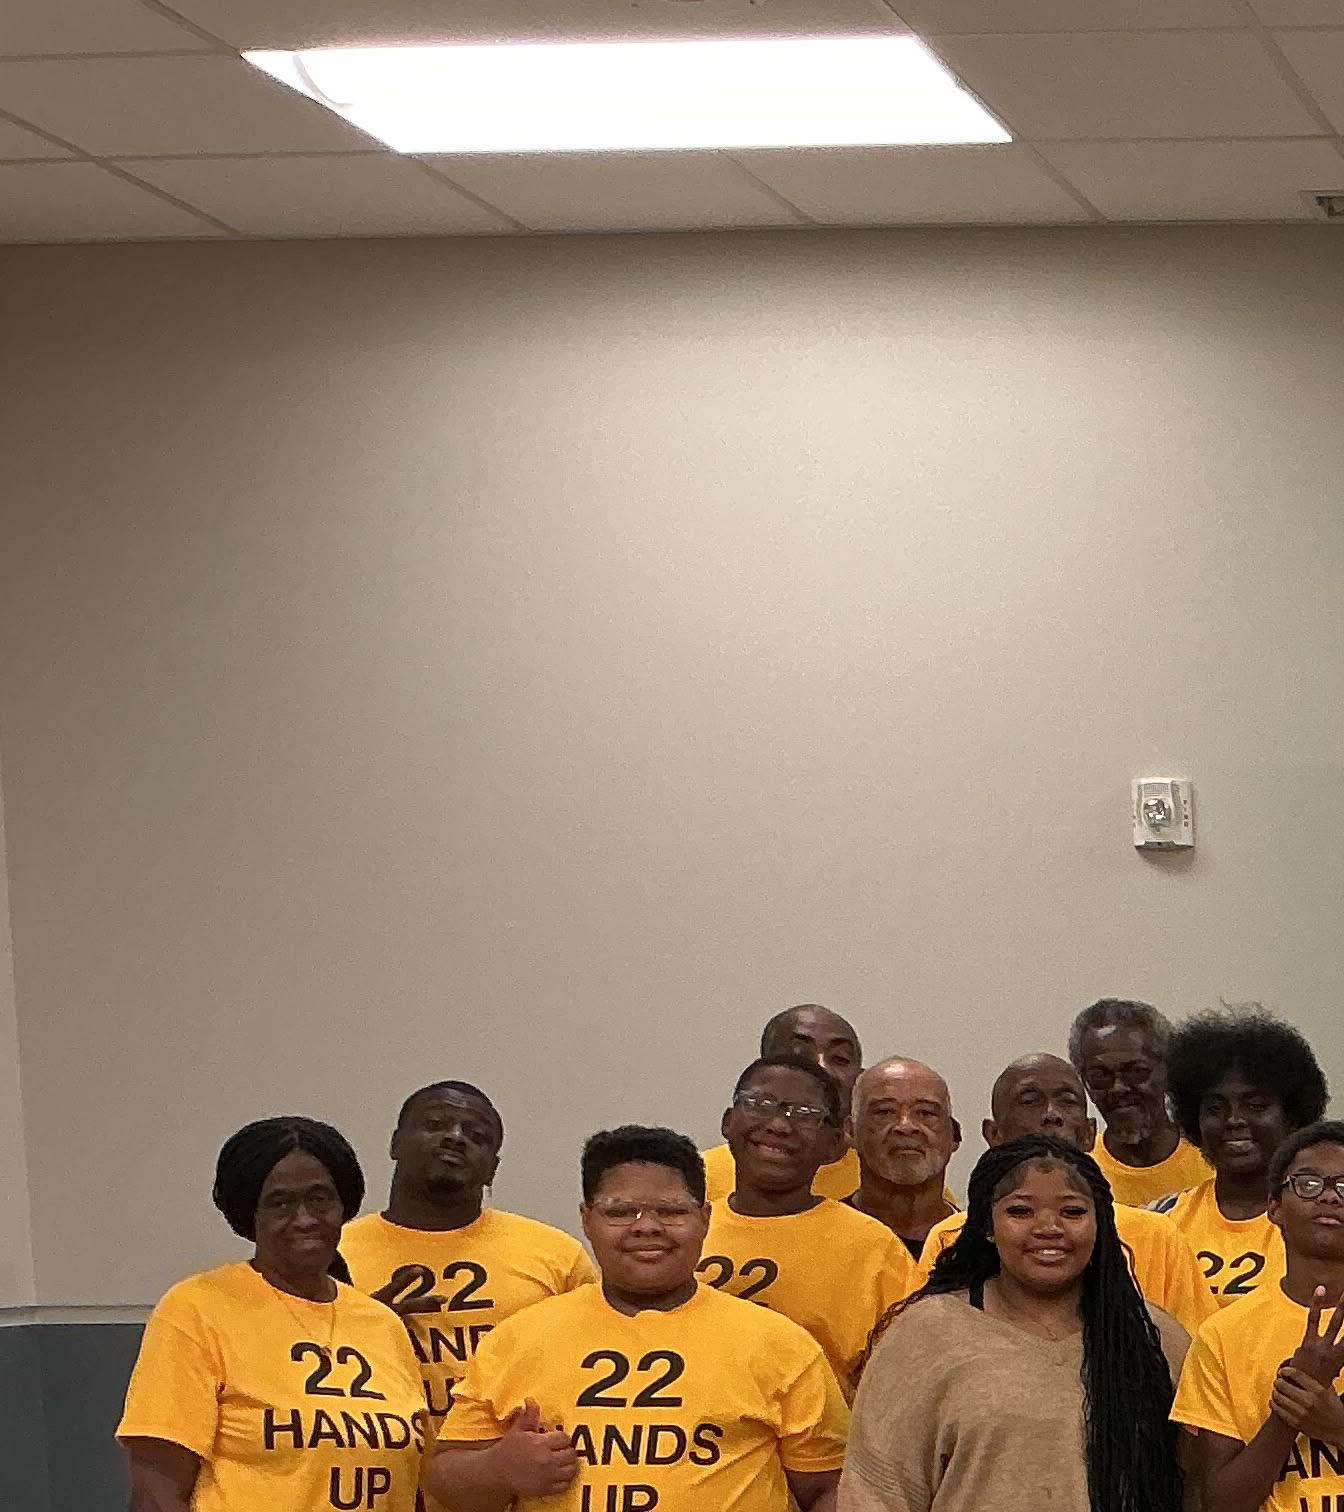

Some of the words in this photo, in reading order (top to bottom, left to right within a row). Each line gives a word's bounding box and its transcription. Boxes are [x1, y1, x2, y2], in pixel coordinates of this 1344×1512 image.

[389, 1261, 495, 1313] 22
[292, 1342, 387, 1400] 22
[576, 1350, 686, 1408] 22
[555, 1423, 725, 1466] ANDS
[329, 1466, 392, 1511] UP
